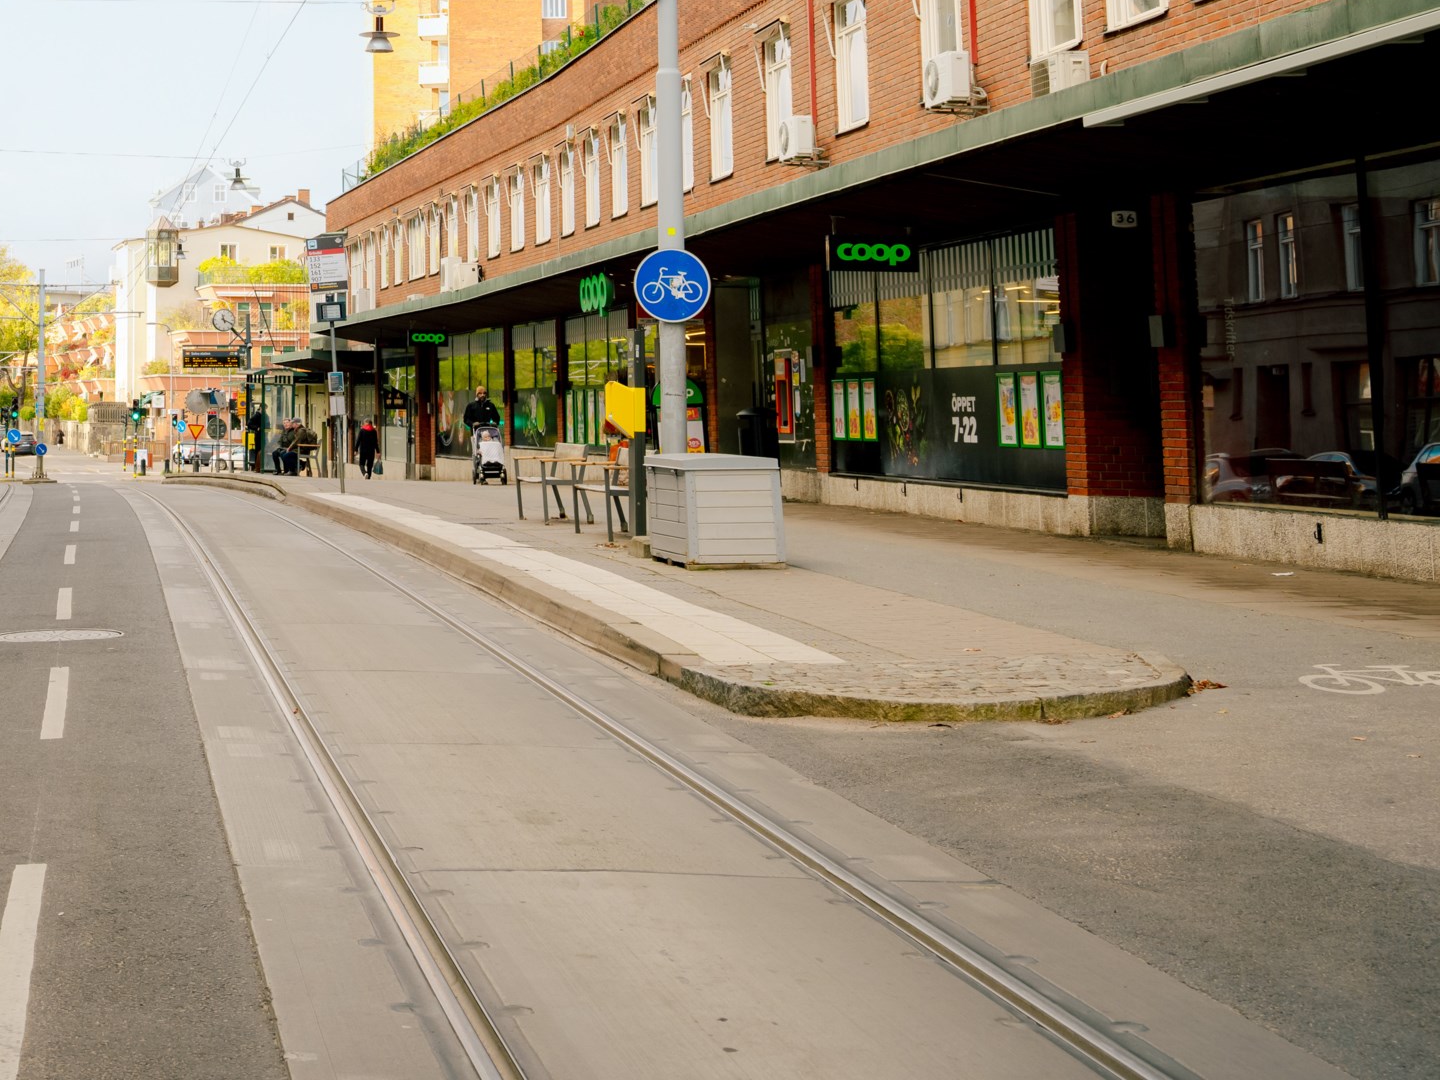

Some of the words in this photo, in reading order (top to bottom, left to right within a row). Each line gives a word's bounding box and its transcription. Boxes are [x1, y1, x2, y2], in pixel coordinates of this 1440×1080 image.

[1116, 213, 1135, 224] 36
[837, 242, 911, 266] coop
[579, 272, 608, 318] coop
[411, 333, 446, 345] coop
[951, 392, 976, 412] ÖPPET
[951, 416, 979, 444] 7-22
